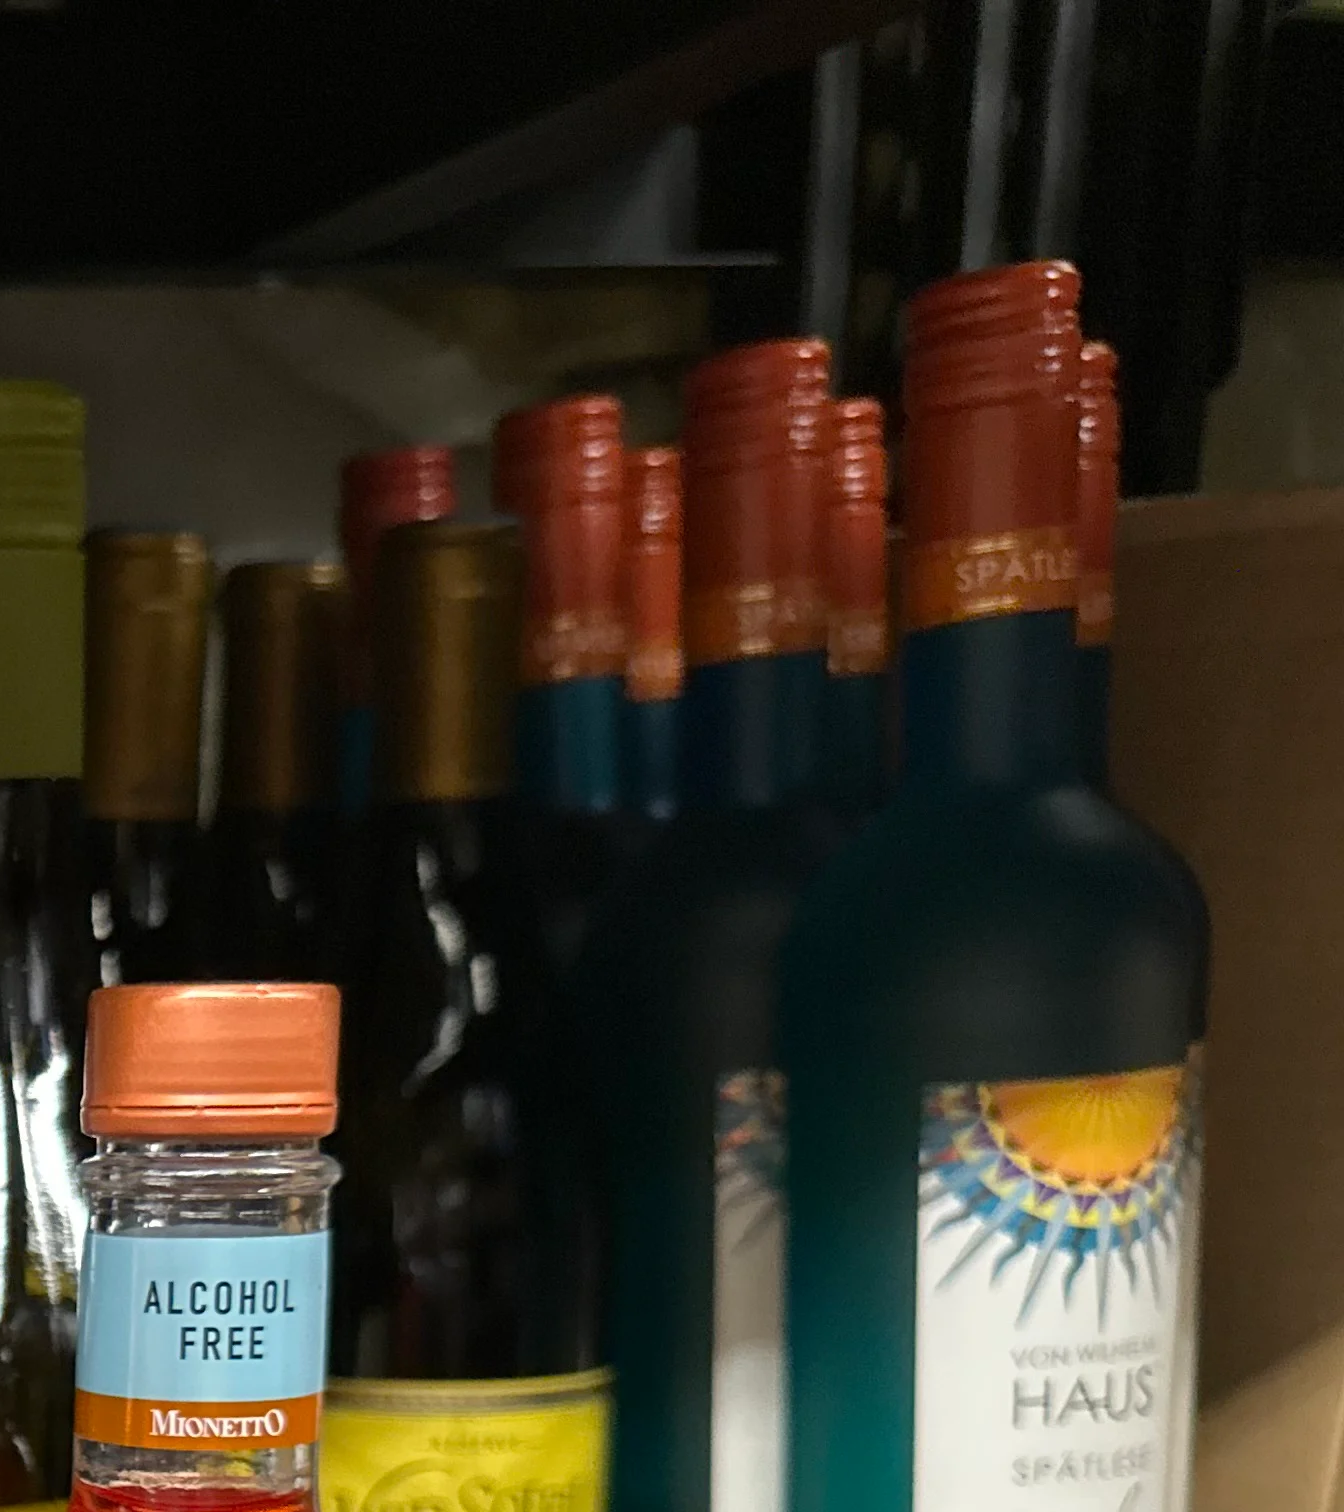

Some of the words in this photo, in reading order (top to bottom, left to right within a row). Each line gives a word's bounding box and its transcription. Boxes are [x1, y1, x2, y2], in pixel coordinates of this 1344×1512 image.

[143, 1279, 295, 1315] ALCOHOL
[179, 1326, 265, 1360] FREE
[1009, 1344, 1070, 1370] VON
[1012, 1365, 1155, 1430] HAUS
[149, 1408, 286, 1438] MIONETTO
